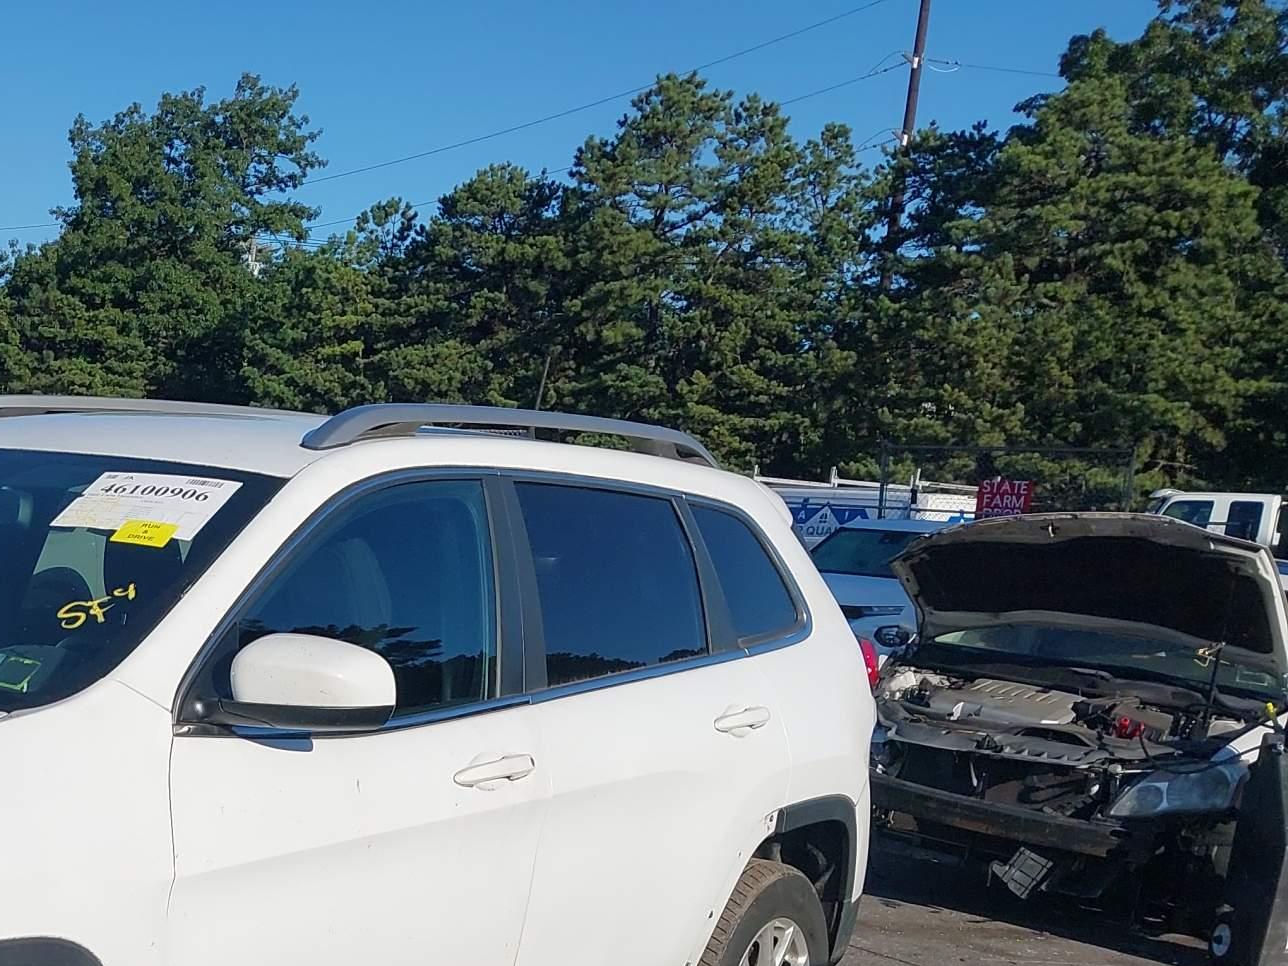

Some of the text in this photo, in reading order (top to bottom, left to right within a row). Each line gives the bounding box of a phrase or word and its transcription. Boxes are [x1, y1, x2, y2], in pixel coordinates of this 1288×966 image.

[100, 483, 210, 502] 46100906
[982, 479, 1029, 494] STATE
[982, 494, 1025, 509] FARM
